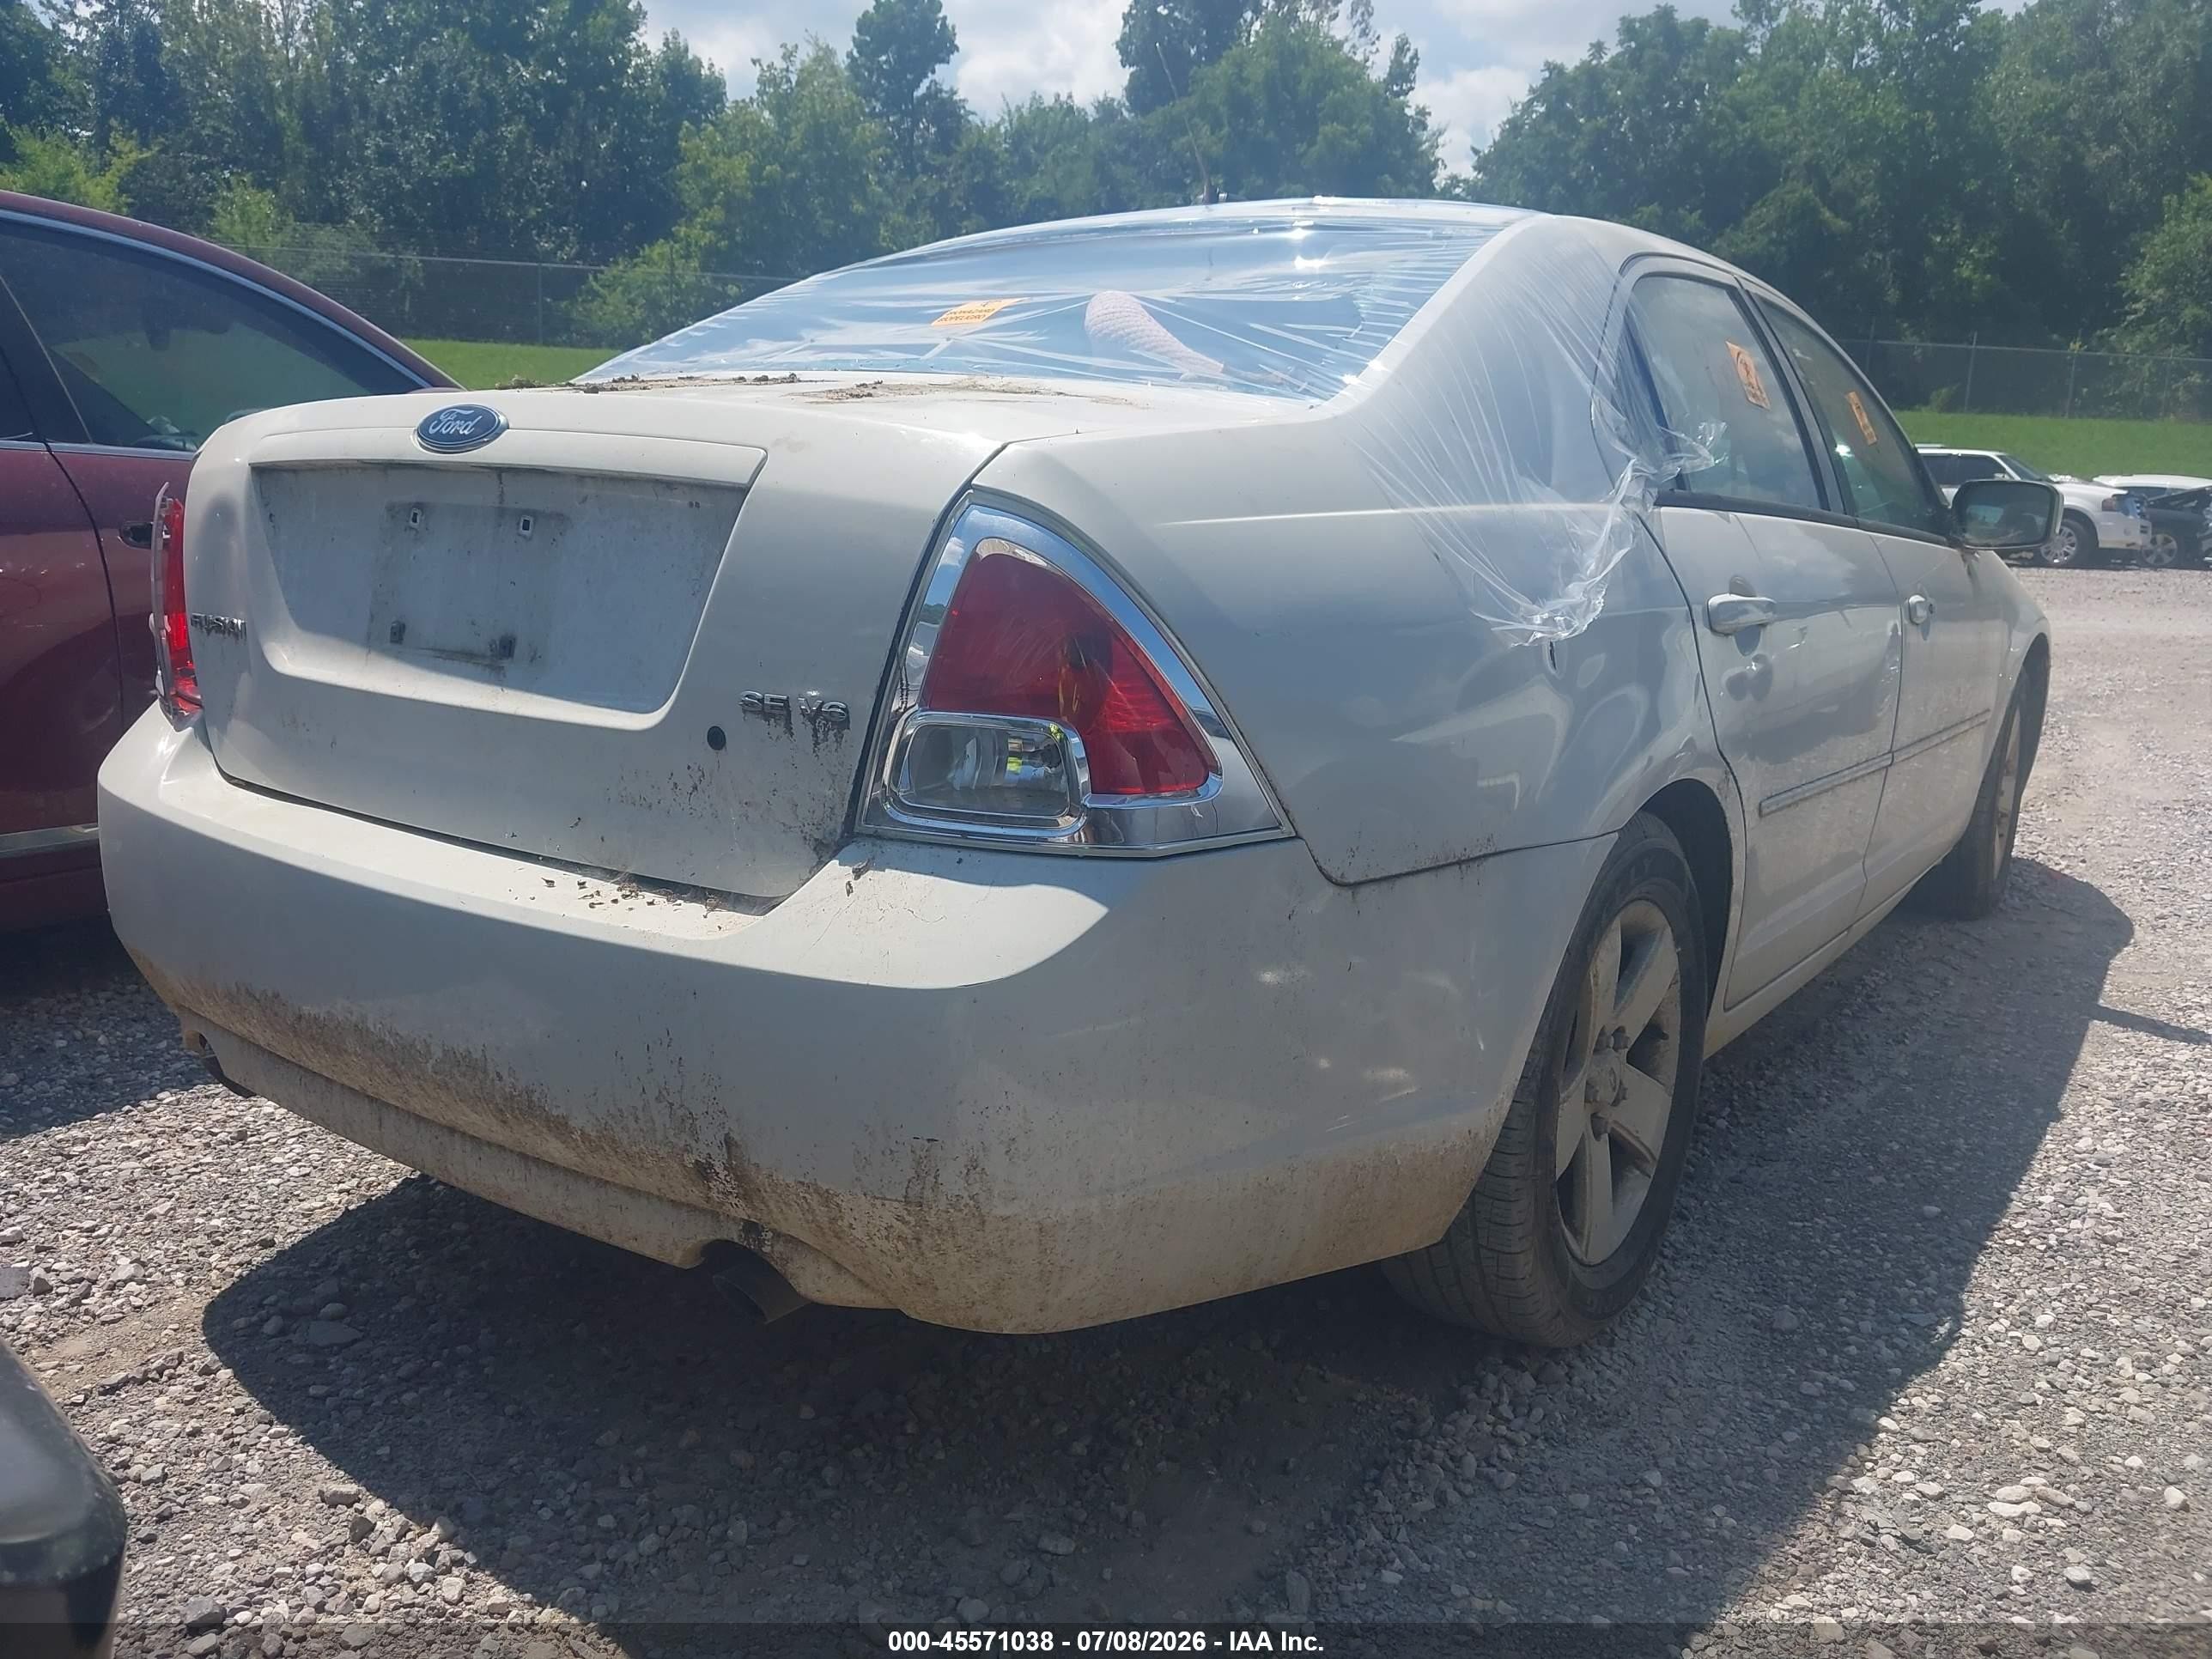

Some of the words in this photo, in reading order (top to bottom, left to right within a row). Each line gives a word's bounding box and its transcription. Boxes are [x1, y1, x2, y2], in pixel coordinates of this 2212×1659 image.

[428, 408, 483, 435] Ford
[739, 690, 790, 714] SE
[797, 696, 848, 722] V6
